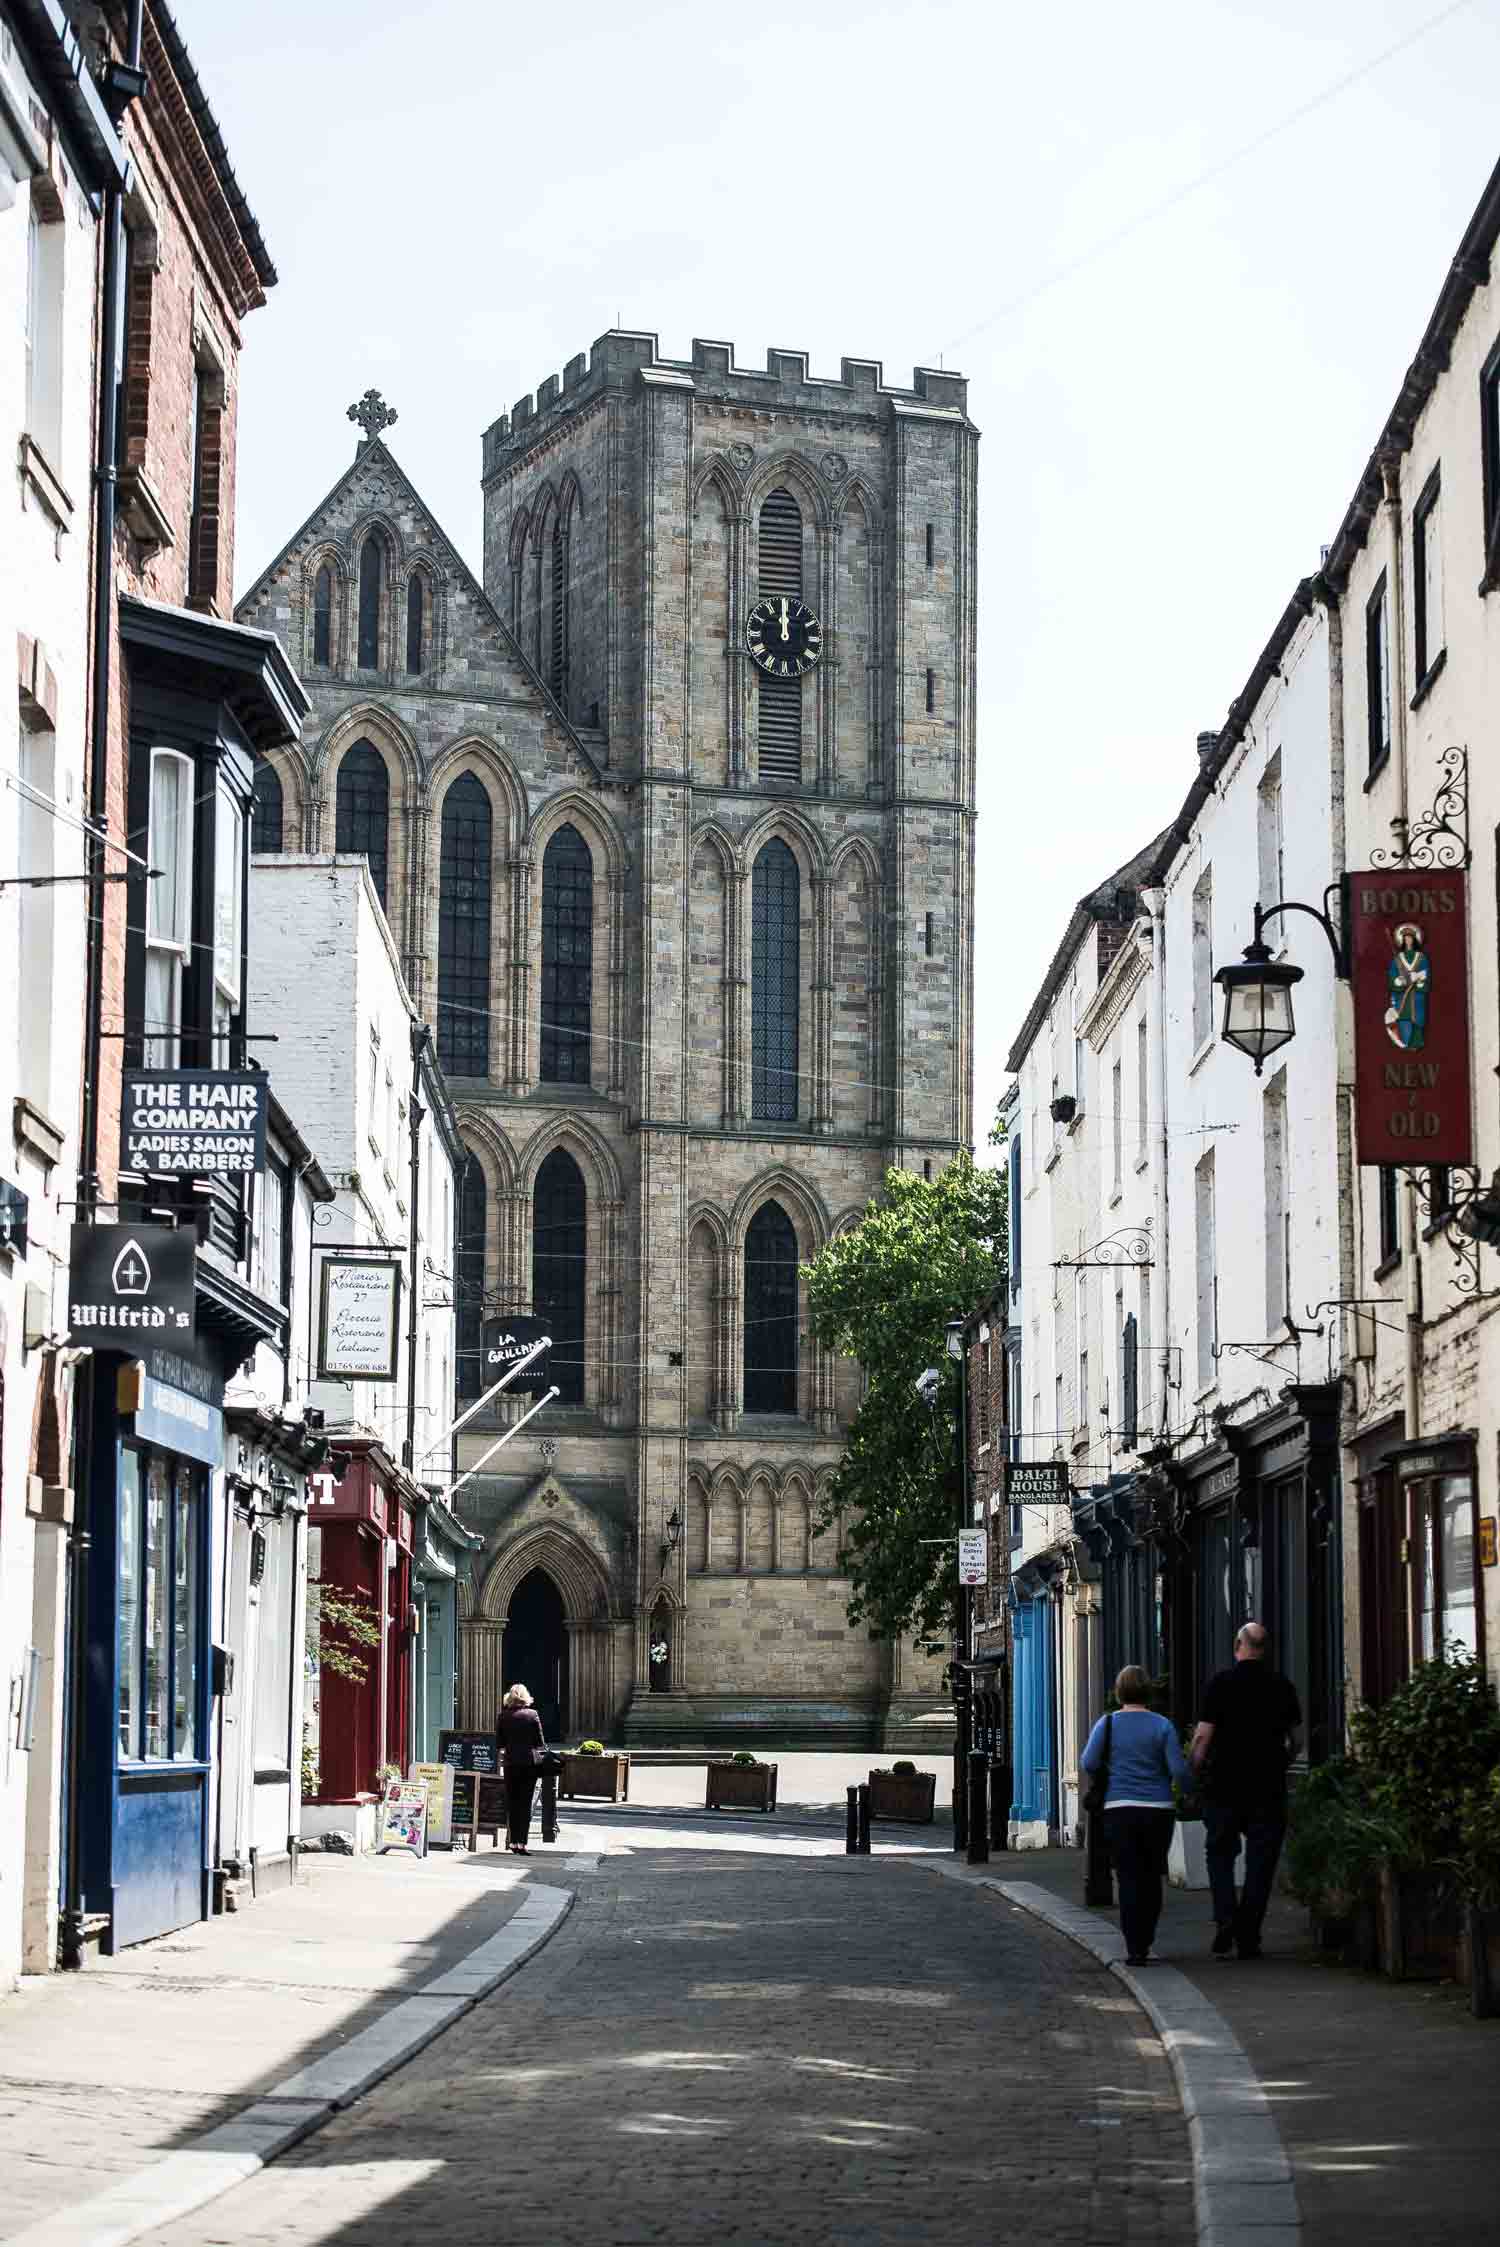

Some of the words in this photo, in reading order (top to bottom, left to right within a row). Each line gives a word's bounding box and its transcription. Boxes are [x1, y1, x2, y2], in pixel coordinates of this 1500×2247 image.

[1361, 889, 1456, 914] BOOKS
[1384, 1063, 1440, 1090] NEW
[131, 1083, 181, 1107] THE
[188, 1084, 258, 1107] HAIR
[132, 1108, 258, 1130] COMPANY
[1388, 1112, 1441, 1138] OLD
[128, 1135, 190, 1152] LADIES
[192, 1136, 255, 1153] SALON
[130, 1152, 150, 1169] &
[158, 1153, 255, 1170] BARBERS
[353, 1292, 368, 1303] 27
[71, 1304, 190, 1328] Wilfrid's
[498, 1334, 516, 1346] LA
[1012, 1469, 1057, 1480] BALTI
[1009, 1480, 1065, 1491] HOUSE
